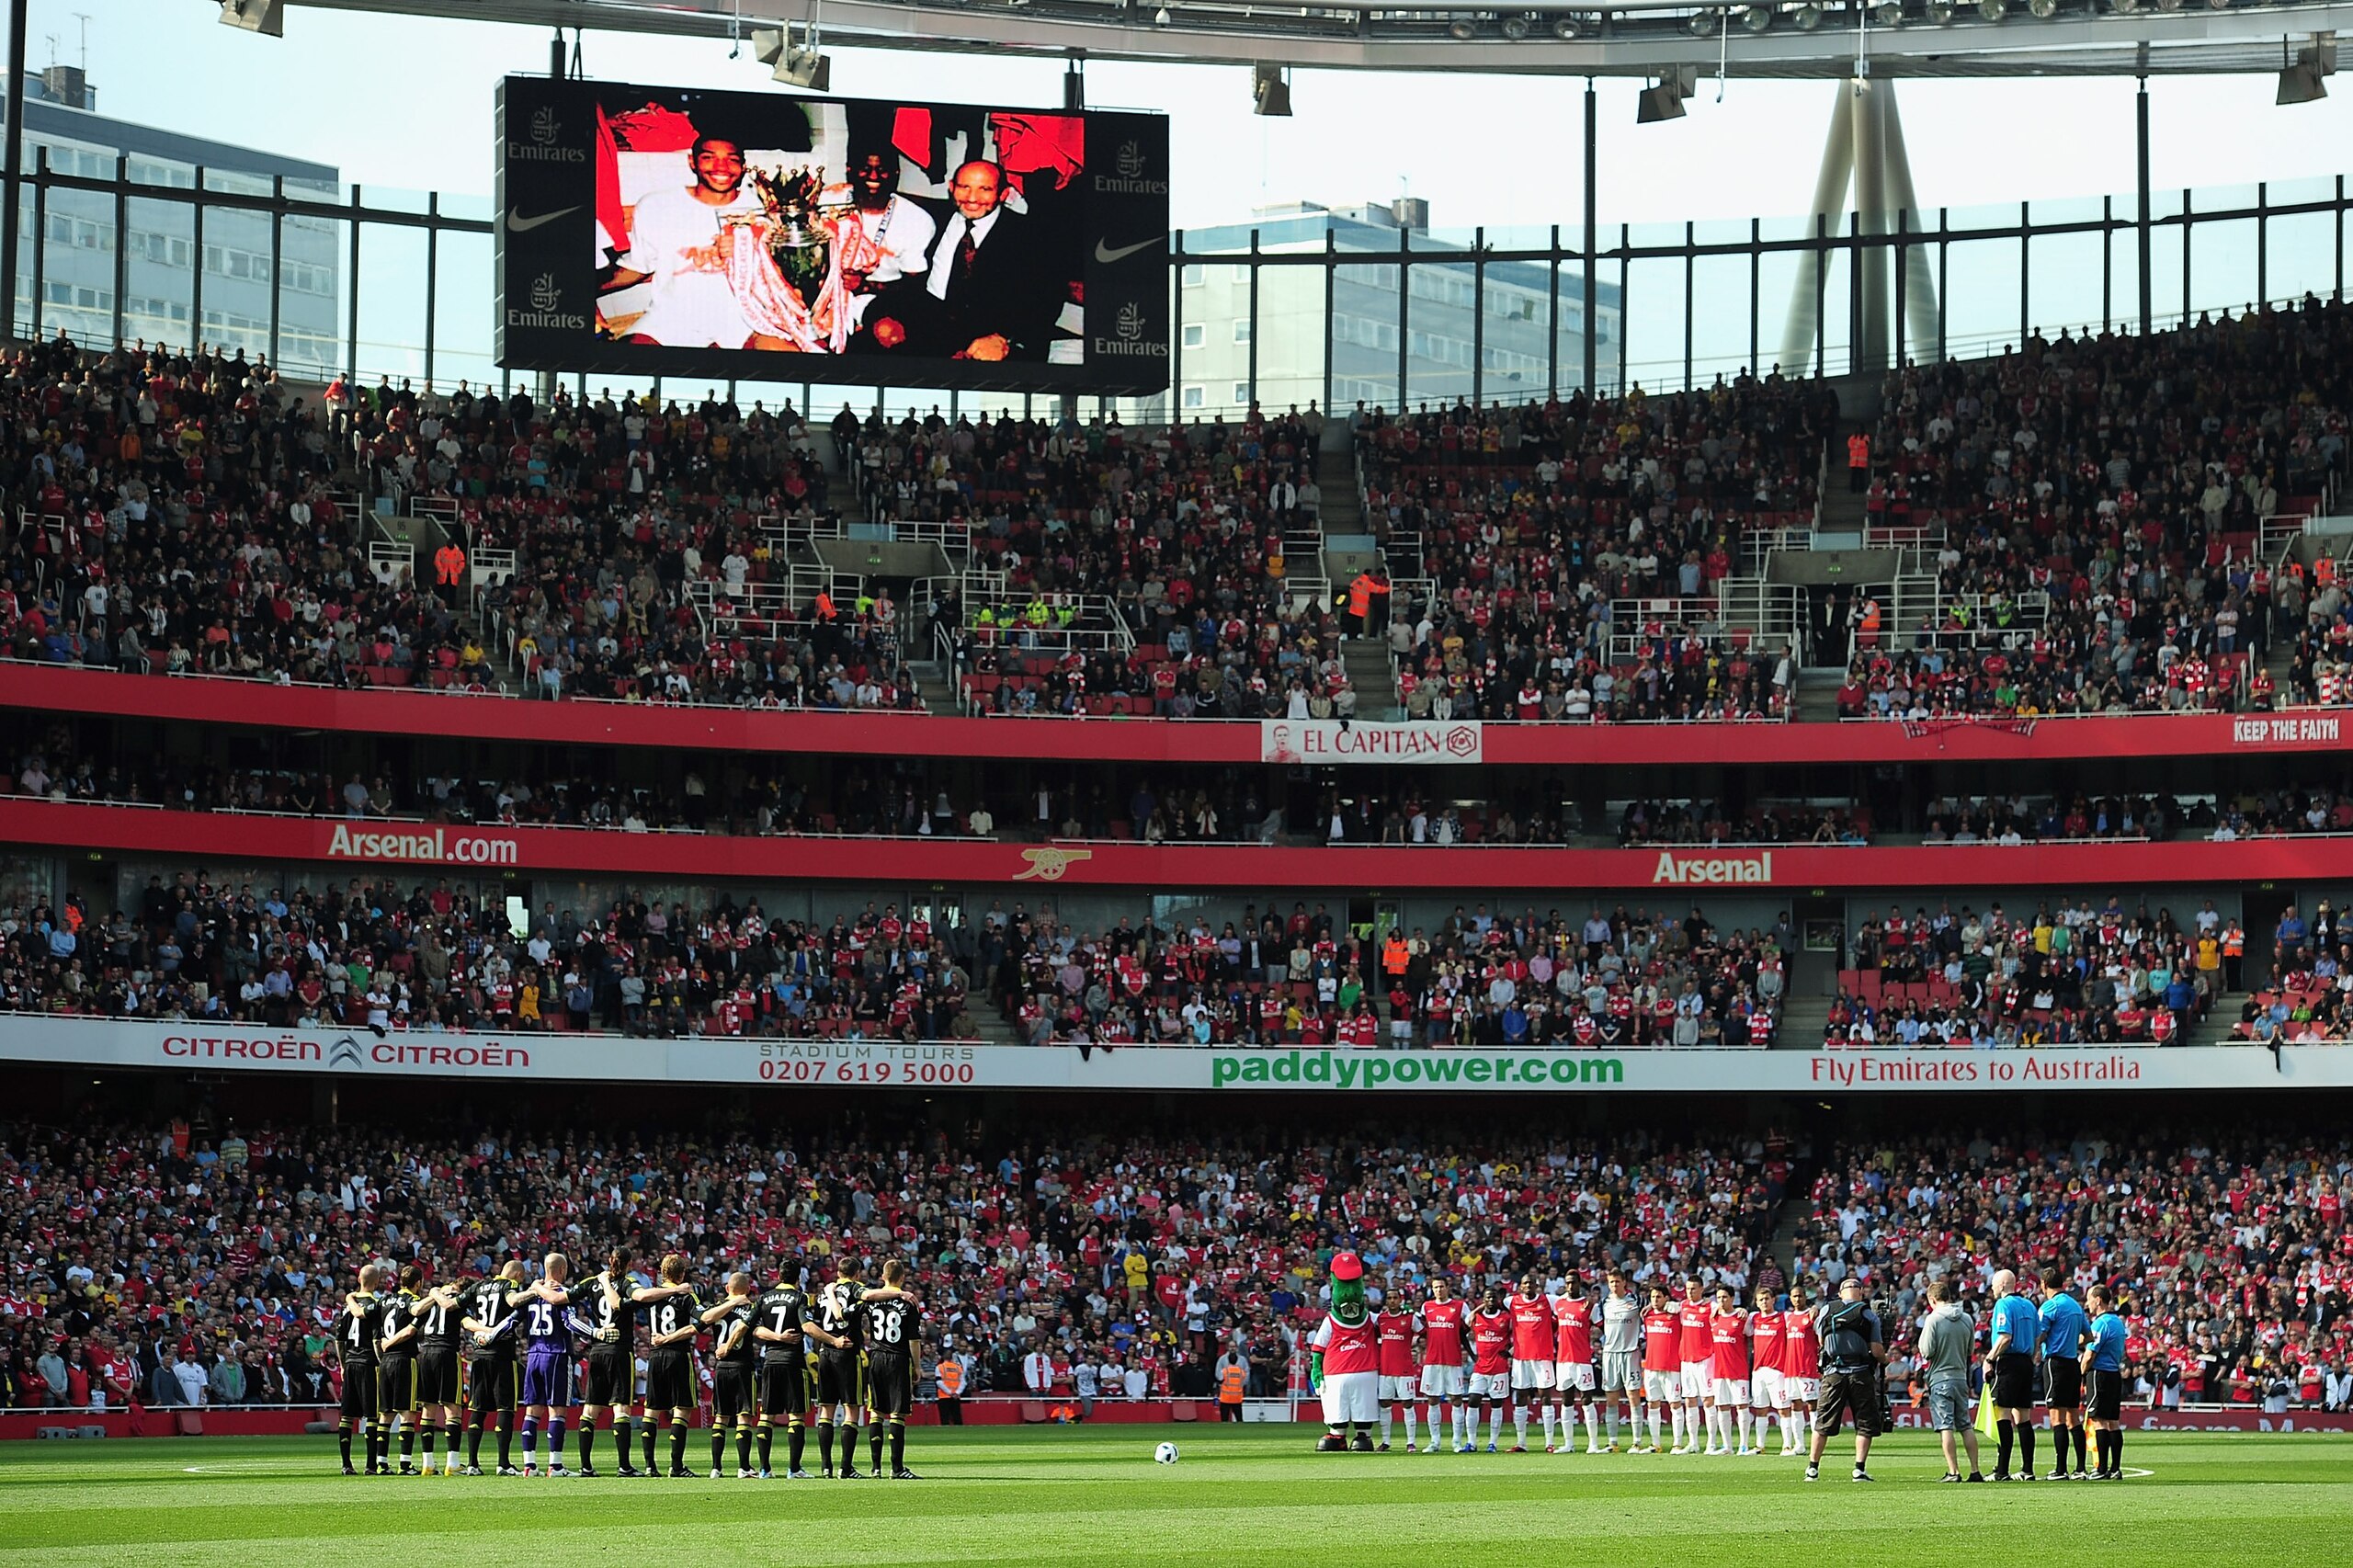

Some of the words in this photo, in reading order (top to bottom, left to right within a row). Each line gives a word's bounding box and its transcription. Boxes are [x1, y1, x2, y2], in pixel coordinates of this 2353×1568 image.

[508, 142, 585, 162] Emirates
[1095, 175, 1168, 195] Emirates
[507, 309, 585, 329] Emirates
[1095, 337, 1168, 357] Emirates
[1303, 730, 1327, 753] EL
[1335, 730, 1440, 754] CAPITAN
[2234, 720, 2268, 742] KEEP
[2271, 719, 2298, 741] THE
[2301, 718, 2339, 741] FAITH
[327, 824, 517, 864] Arsenal.com
[1653, 851, 1772, 883] Arsenal
[759, 1044, 871, 1058] STADIUM
[885, 1047, 974, 1060] TOURS
[759, 1060, 826, 1081] 0207
[836, 1061, 891, 1083] 619
[902, 1062, 974, 1083] 5000
[1211, 1051, 1624, 1088] paddypower.com
[1811, 1057, 1855, 1086] Fly
[1861, 1056, 1977, 1082] Emirates
[1988, 1059, 2014, 1082] to
[2023, 1056, 2140, 1081] Australia
[383, 1308, 396, 1340] 6
[424, 1302, 447, 1335] 21
[476, 1292, 500, 1327] 37
[528, 1303, 553, 1336] 25
[598, 1294, 613, 1327] 9
[650, 1304, 676, 1335] 18
[770, 1305, 787, 1335] 7
[347, 1315, 360, 1347] 4
[872, 1308, 902, 1344] 38
[1493, 1380, 1505, 1391] 27
[1582, 1372, 1592, 1383] 20
[1630, 1370, 1641, 1381] 53
[1803, 1381, 1814, 1392] 22
